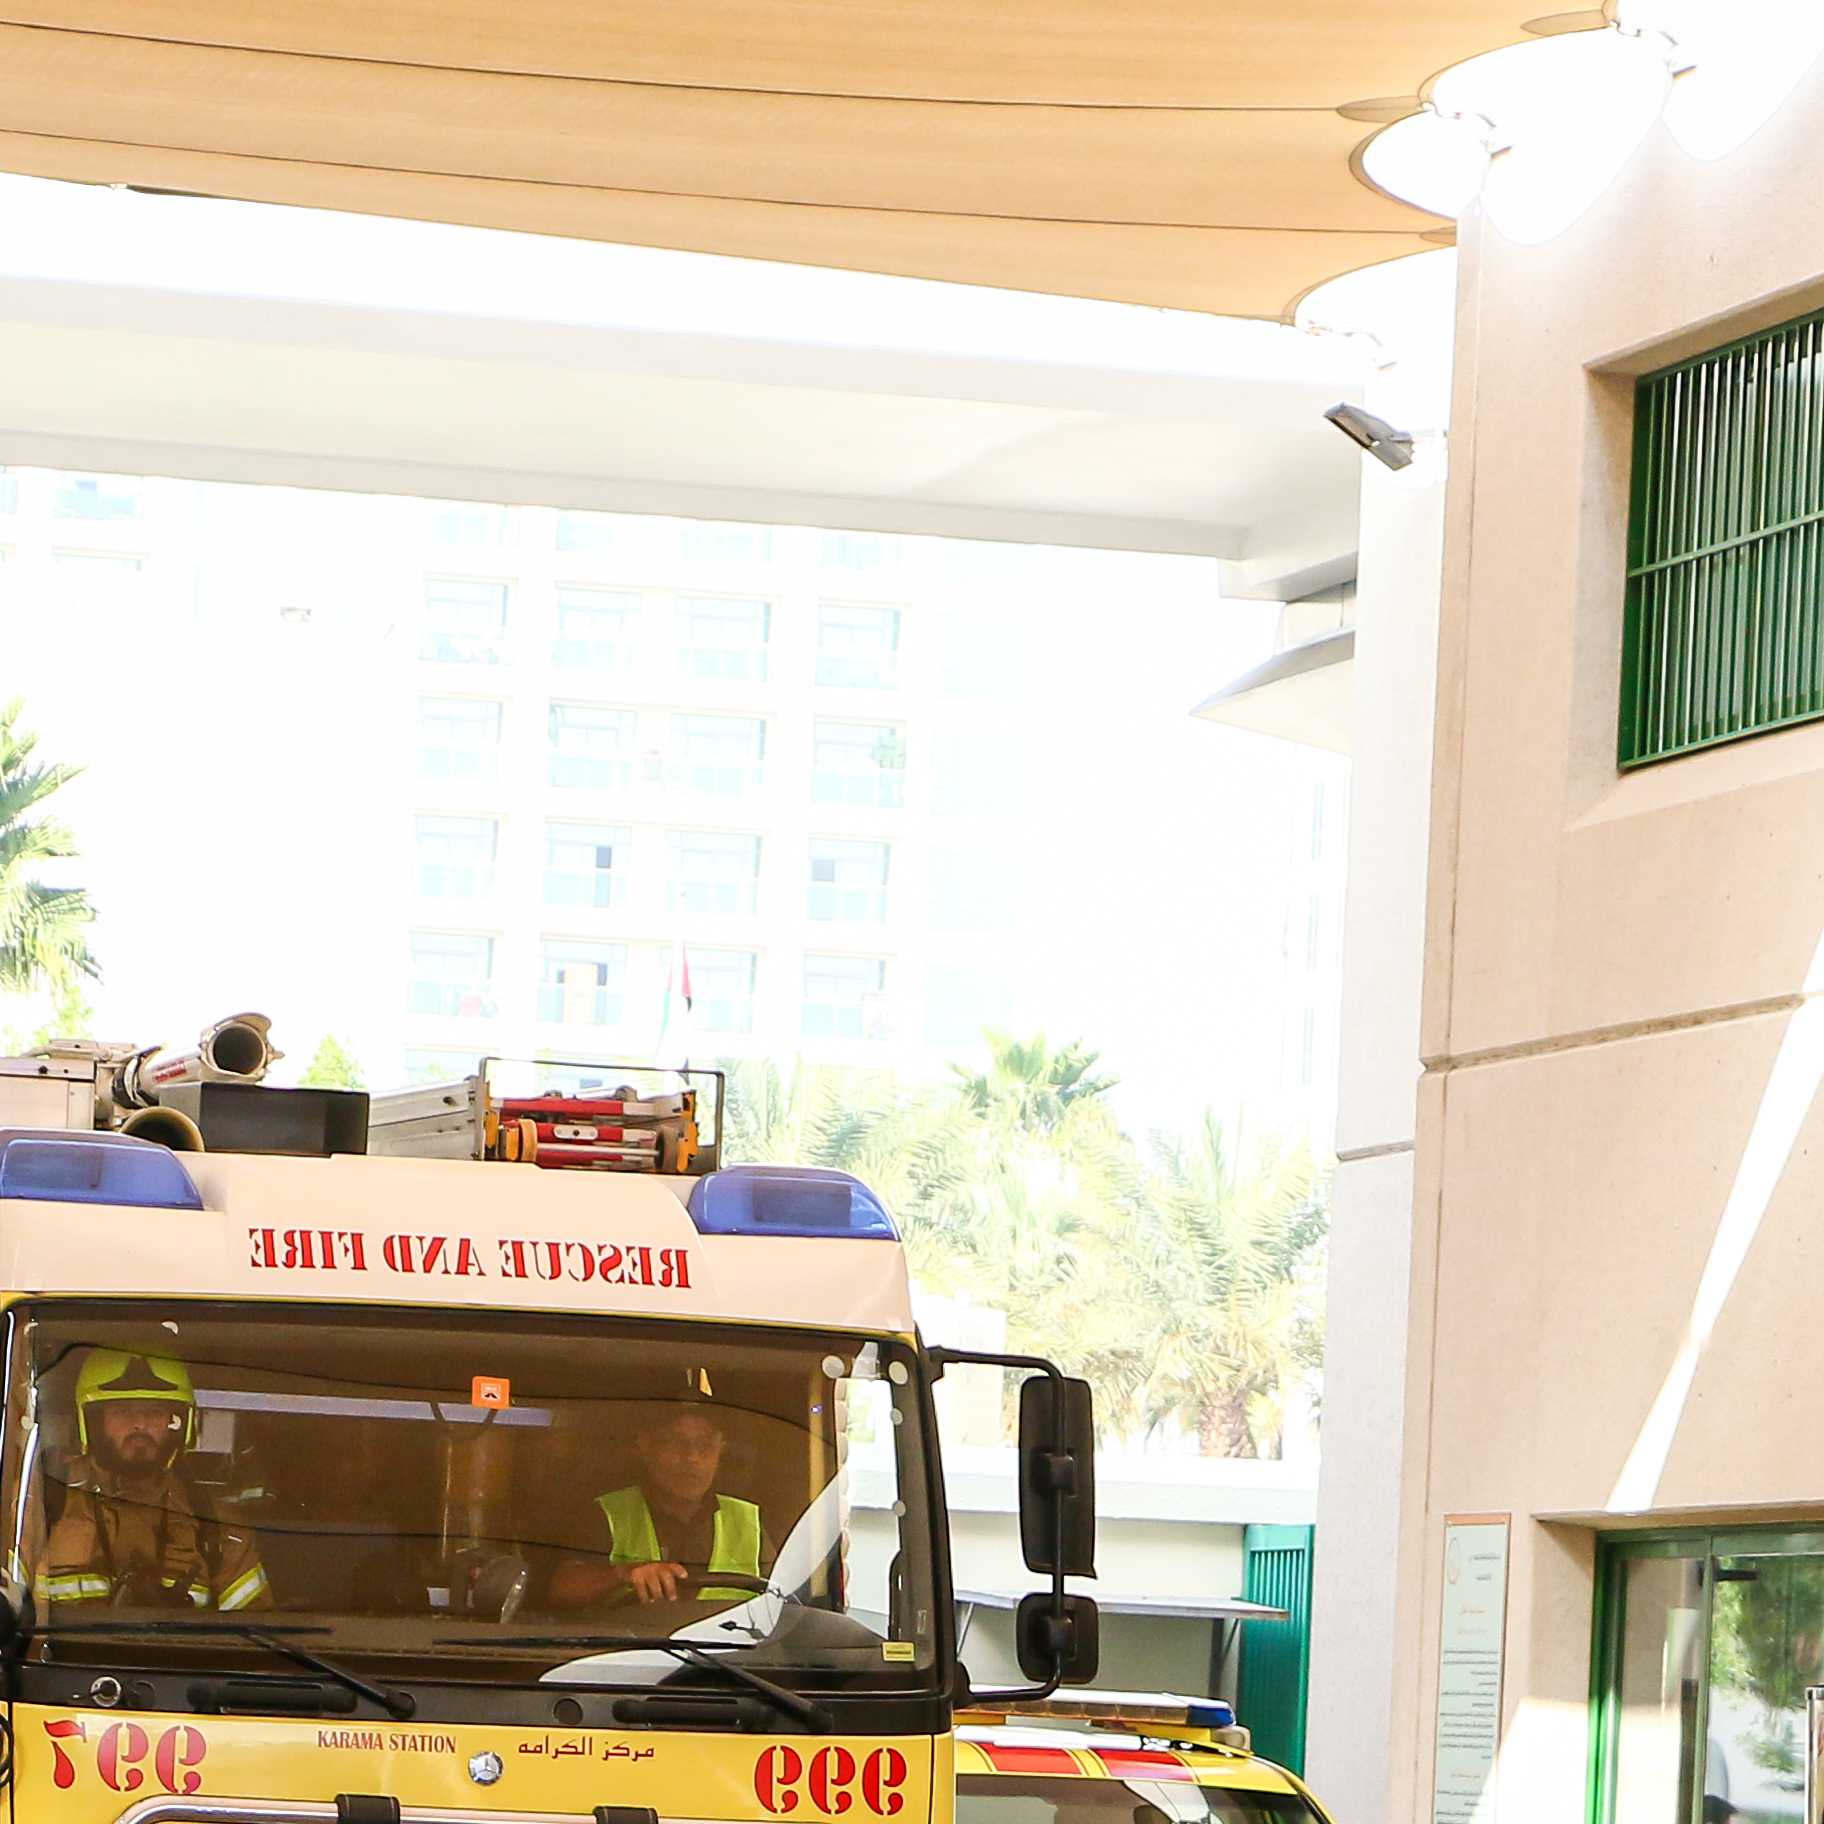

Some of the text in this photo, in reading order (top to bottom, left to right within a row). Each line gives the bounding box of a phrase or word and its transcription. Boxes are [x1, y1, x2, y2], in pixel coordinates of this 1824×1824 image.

[317, 1730, 456, 1754] KARAMA STATION
[518, 1735, 655, 1762] مركز الكرامه
